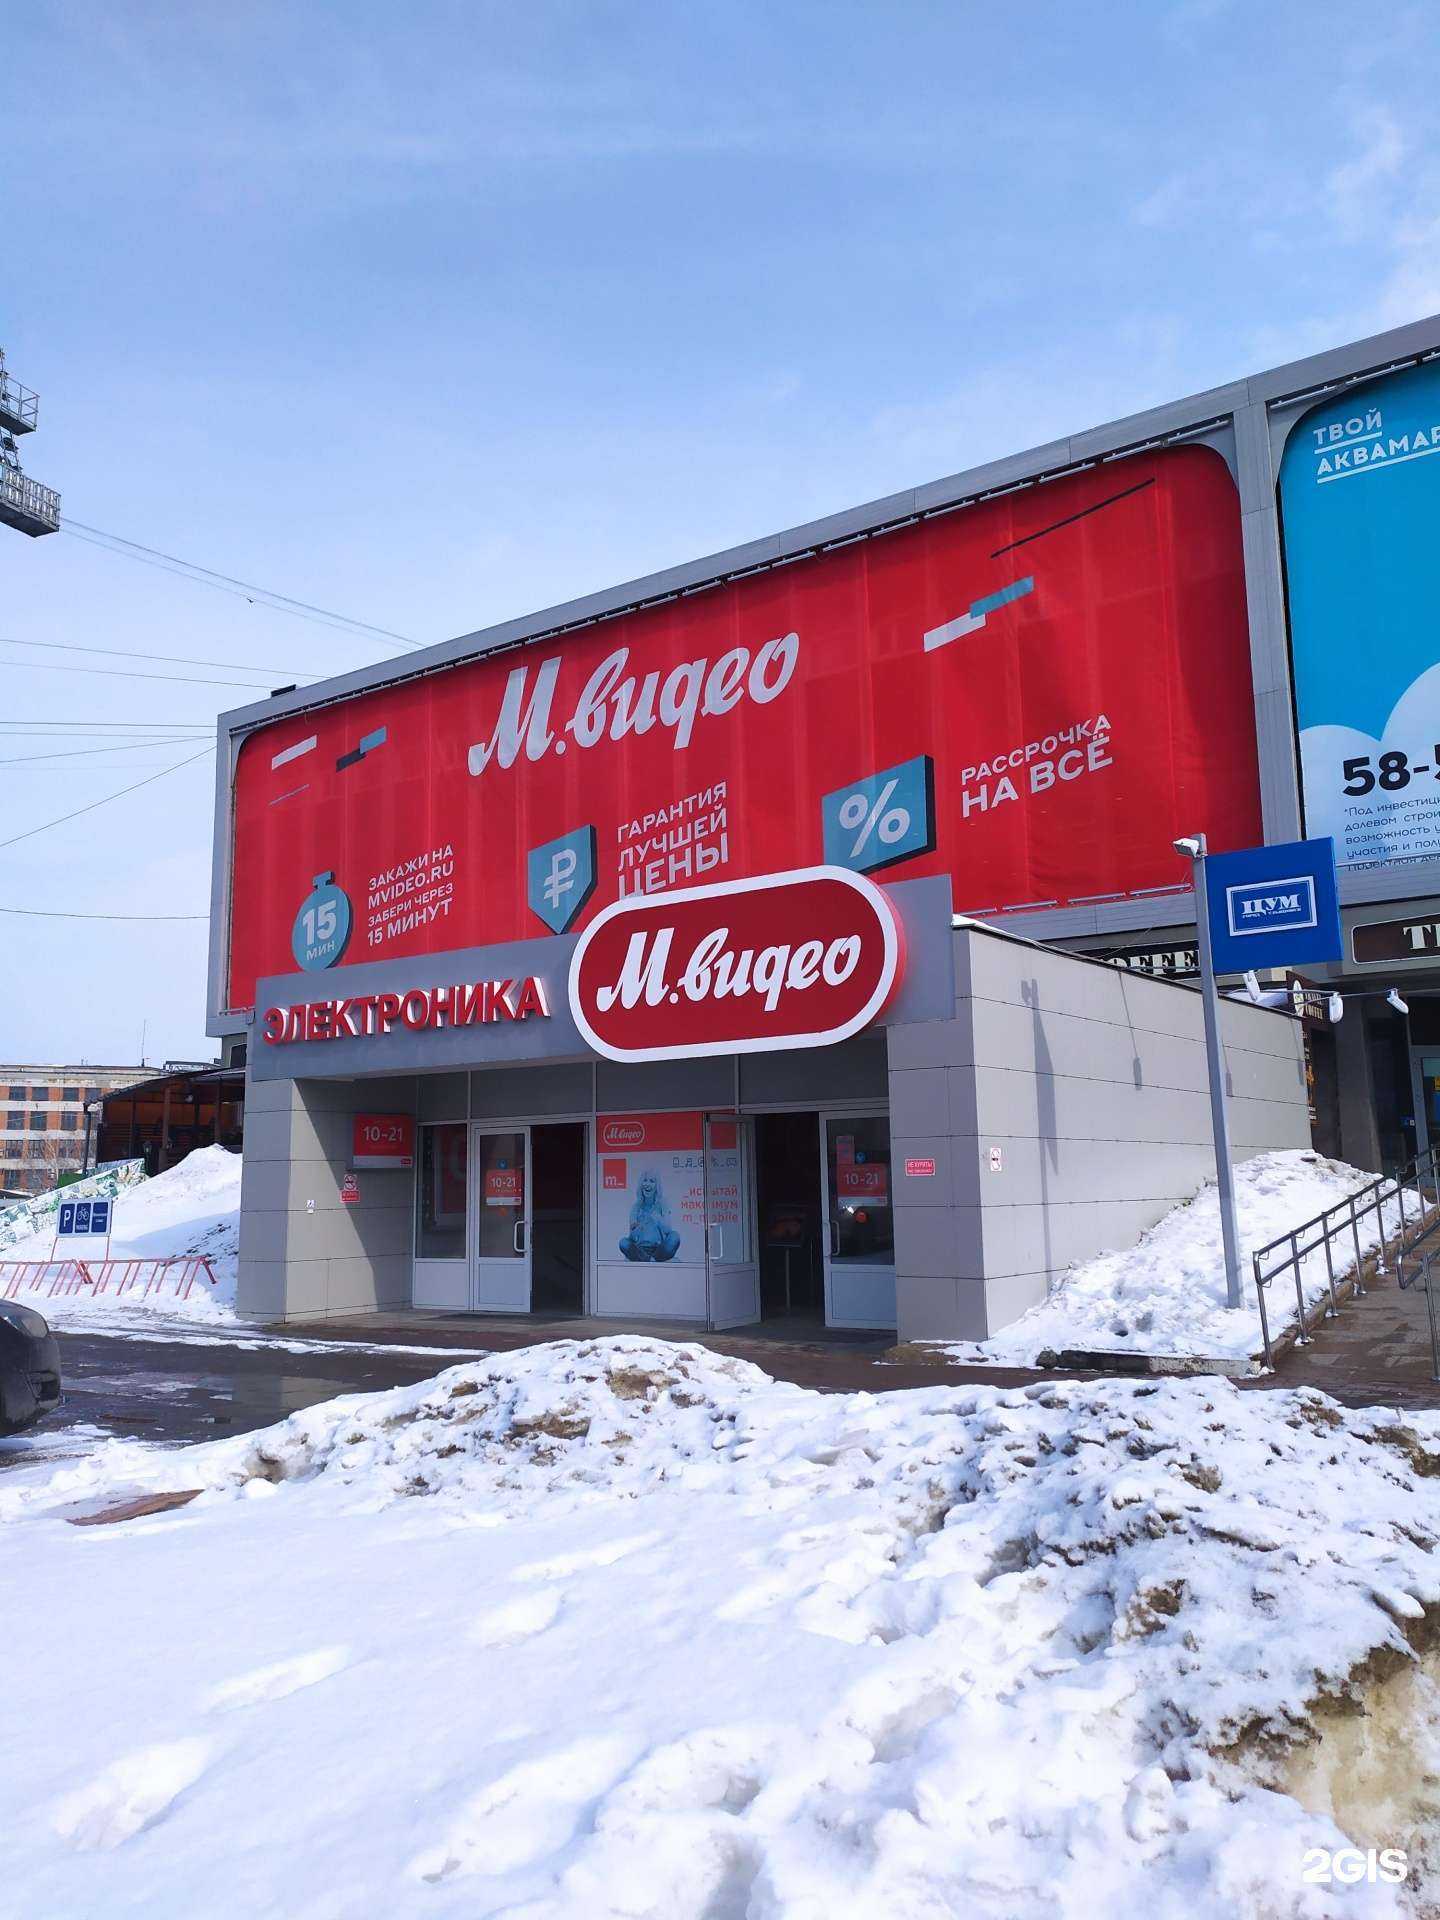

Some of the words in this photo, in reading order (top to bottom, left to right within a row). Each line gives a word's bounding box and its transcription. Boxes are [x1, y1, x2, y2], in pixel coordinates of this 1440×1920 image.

[1313, 407, 1382, 445] ТВОЙ
[961, 714, 1112, 785] РАССРОЧКА
[1342, 743, 1440, 796] 58-
[961, 776, 1019, 818] НА
[1030, 733, 1113, 794] ВСЁ
[617, 781, 727, 843] ГАРАНТИЯ
[1345, 816, 1397, 832] долевом
[1345, 826, 1430, 844] возможность
[618, 804, 727, 872] ЛУЧШЕЙ
[1347, 844, 1398, 859] участия
[1402, 842, 1410, 851] и
[368, 853, 428, 891] ЗАКАЖИ
[432, 844, 453, 863] НА
[368, 861, 454, 910] MVIDEO.RU
[618, 832, 728, 901] ЦЕНЫ
[302, 900, 337, 946] 15
[367, 926, 383, 946] 15
[387, 898, 452, 939] МИНУТ
[368, 899, 411, 927] ЗАБЕРИ
[414, 882, 453, 906] ЧЕРЕЗ
[1241, 893, 1301, 915] ЦУМ
[306, 940, 335, 960] МИН
[262, 976, 550, 1046] ЭЛЕКТРОНИКА
[363, 1126, 403, 1142] 10-21
[490, 1177, 516, 1188] 10-21
[844, 1172, 880, 1185] 10-21
